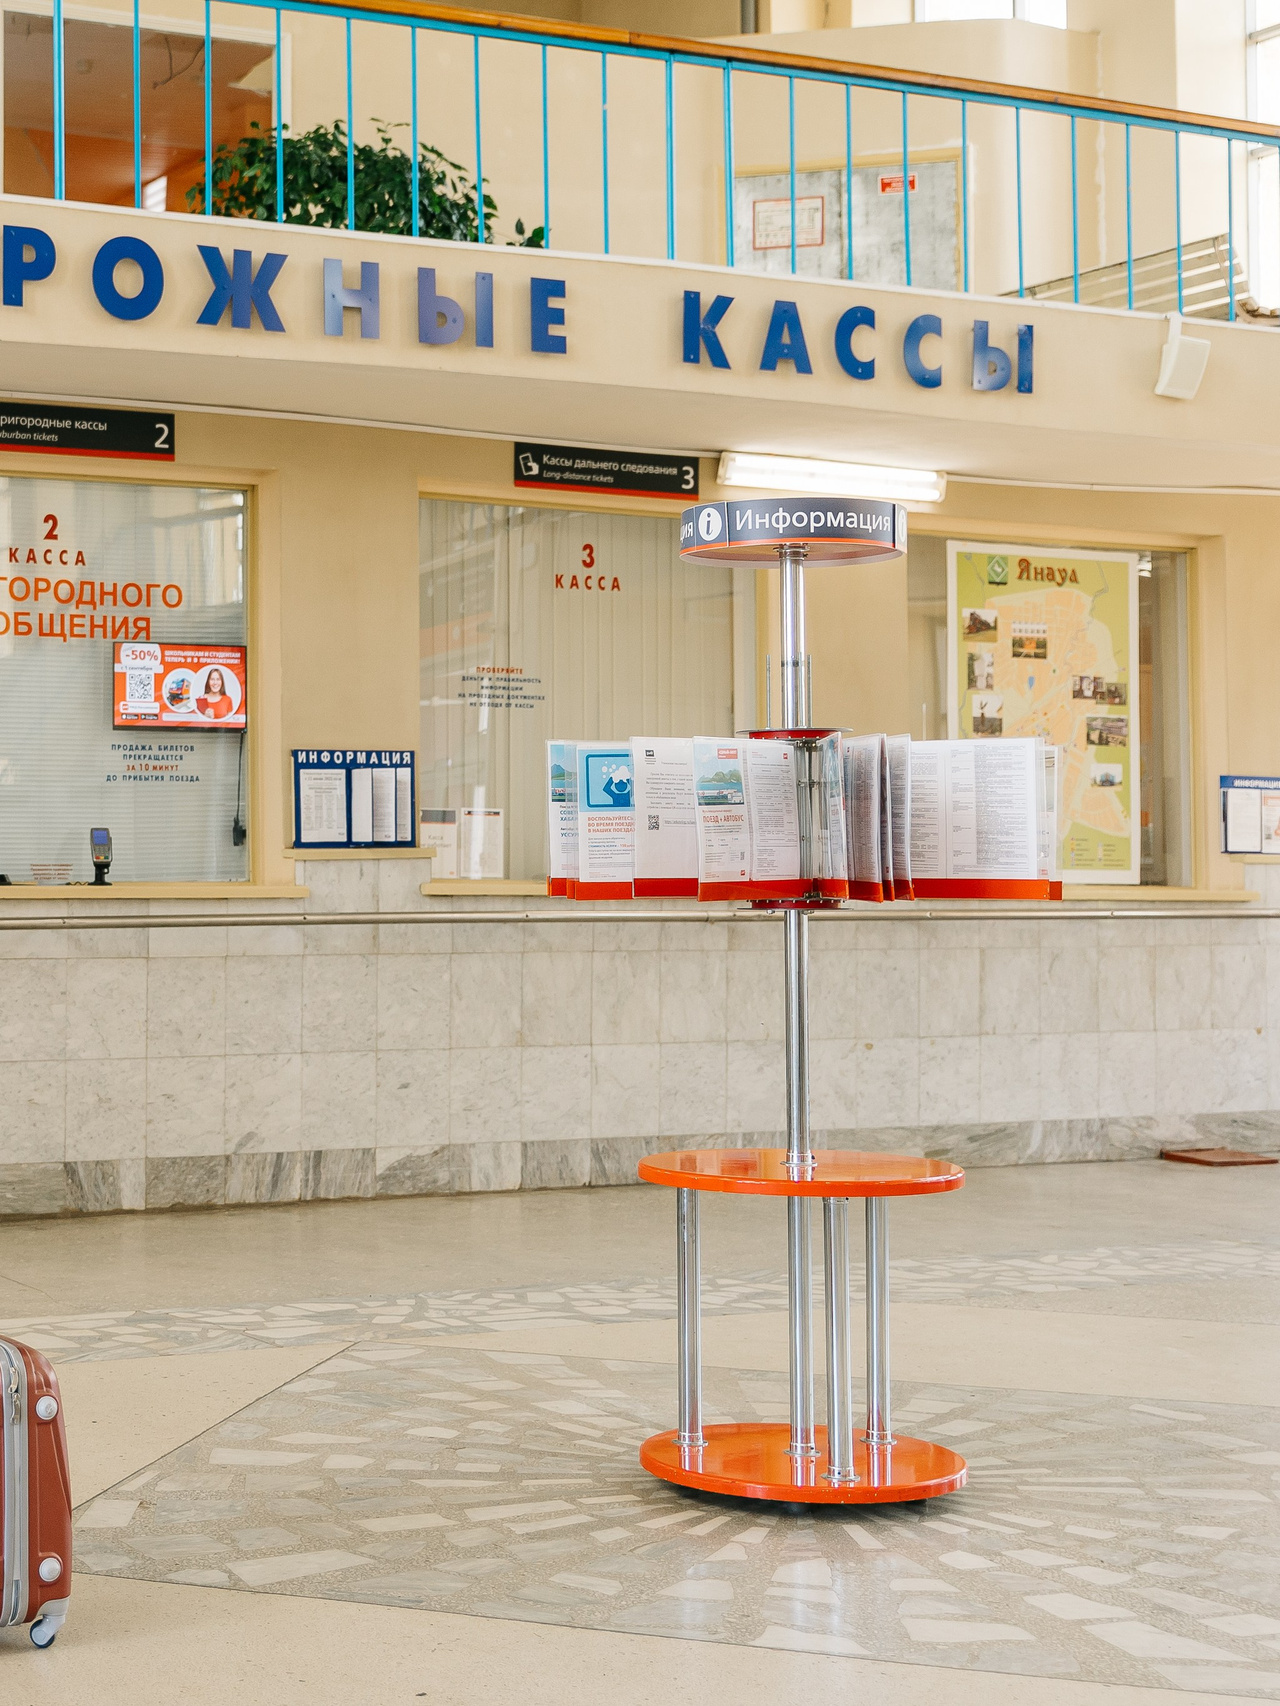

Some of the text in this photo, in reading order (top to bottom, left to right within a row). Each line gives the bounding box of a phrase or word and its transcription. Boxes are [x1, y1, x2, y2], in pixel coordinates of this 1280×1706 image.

[683, 289, 1034, 395] КАССЫ
[32, 432, 59, 442] tickets
[74, 419, 108, 431] кассы
[154, 423, 169, 449] 2
[542, 454, 695, 490] Кассы дальнего следования 3
[542, 470, 614, 484] Long-distance tickets
[43, 513, 59, 541] 2
[735, 506, 892, 534] Информация
[8, 546, 87, 567] КАССА
[581, 543, 595, 569] 3
[554, 574, 621, 592] КАССА
[126, 650, 158, 661] -50%
[476, 666, 523, 674] ПРОВЕРЯЙТЕ
[112, 744, 195, 752] ПРОДАЖА БИЛЕТОВ
[298, 751, 411, 766] ИНФОРМАЦИЯ
[106, 774, 118, 782] ДО
[122, 774, 165, 782] ПРИБЫТИЯ
[1233, 779, 1280, 788] ИНФОРМАЦИ
